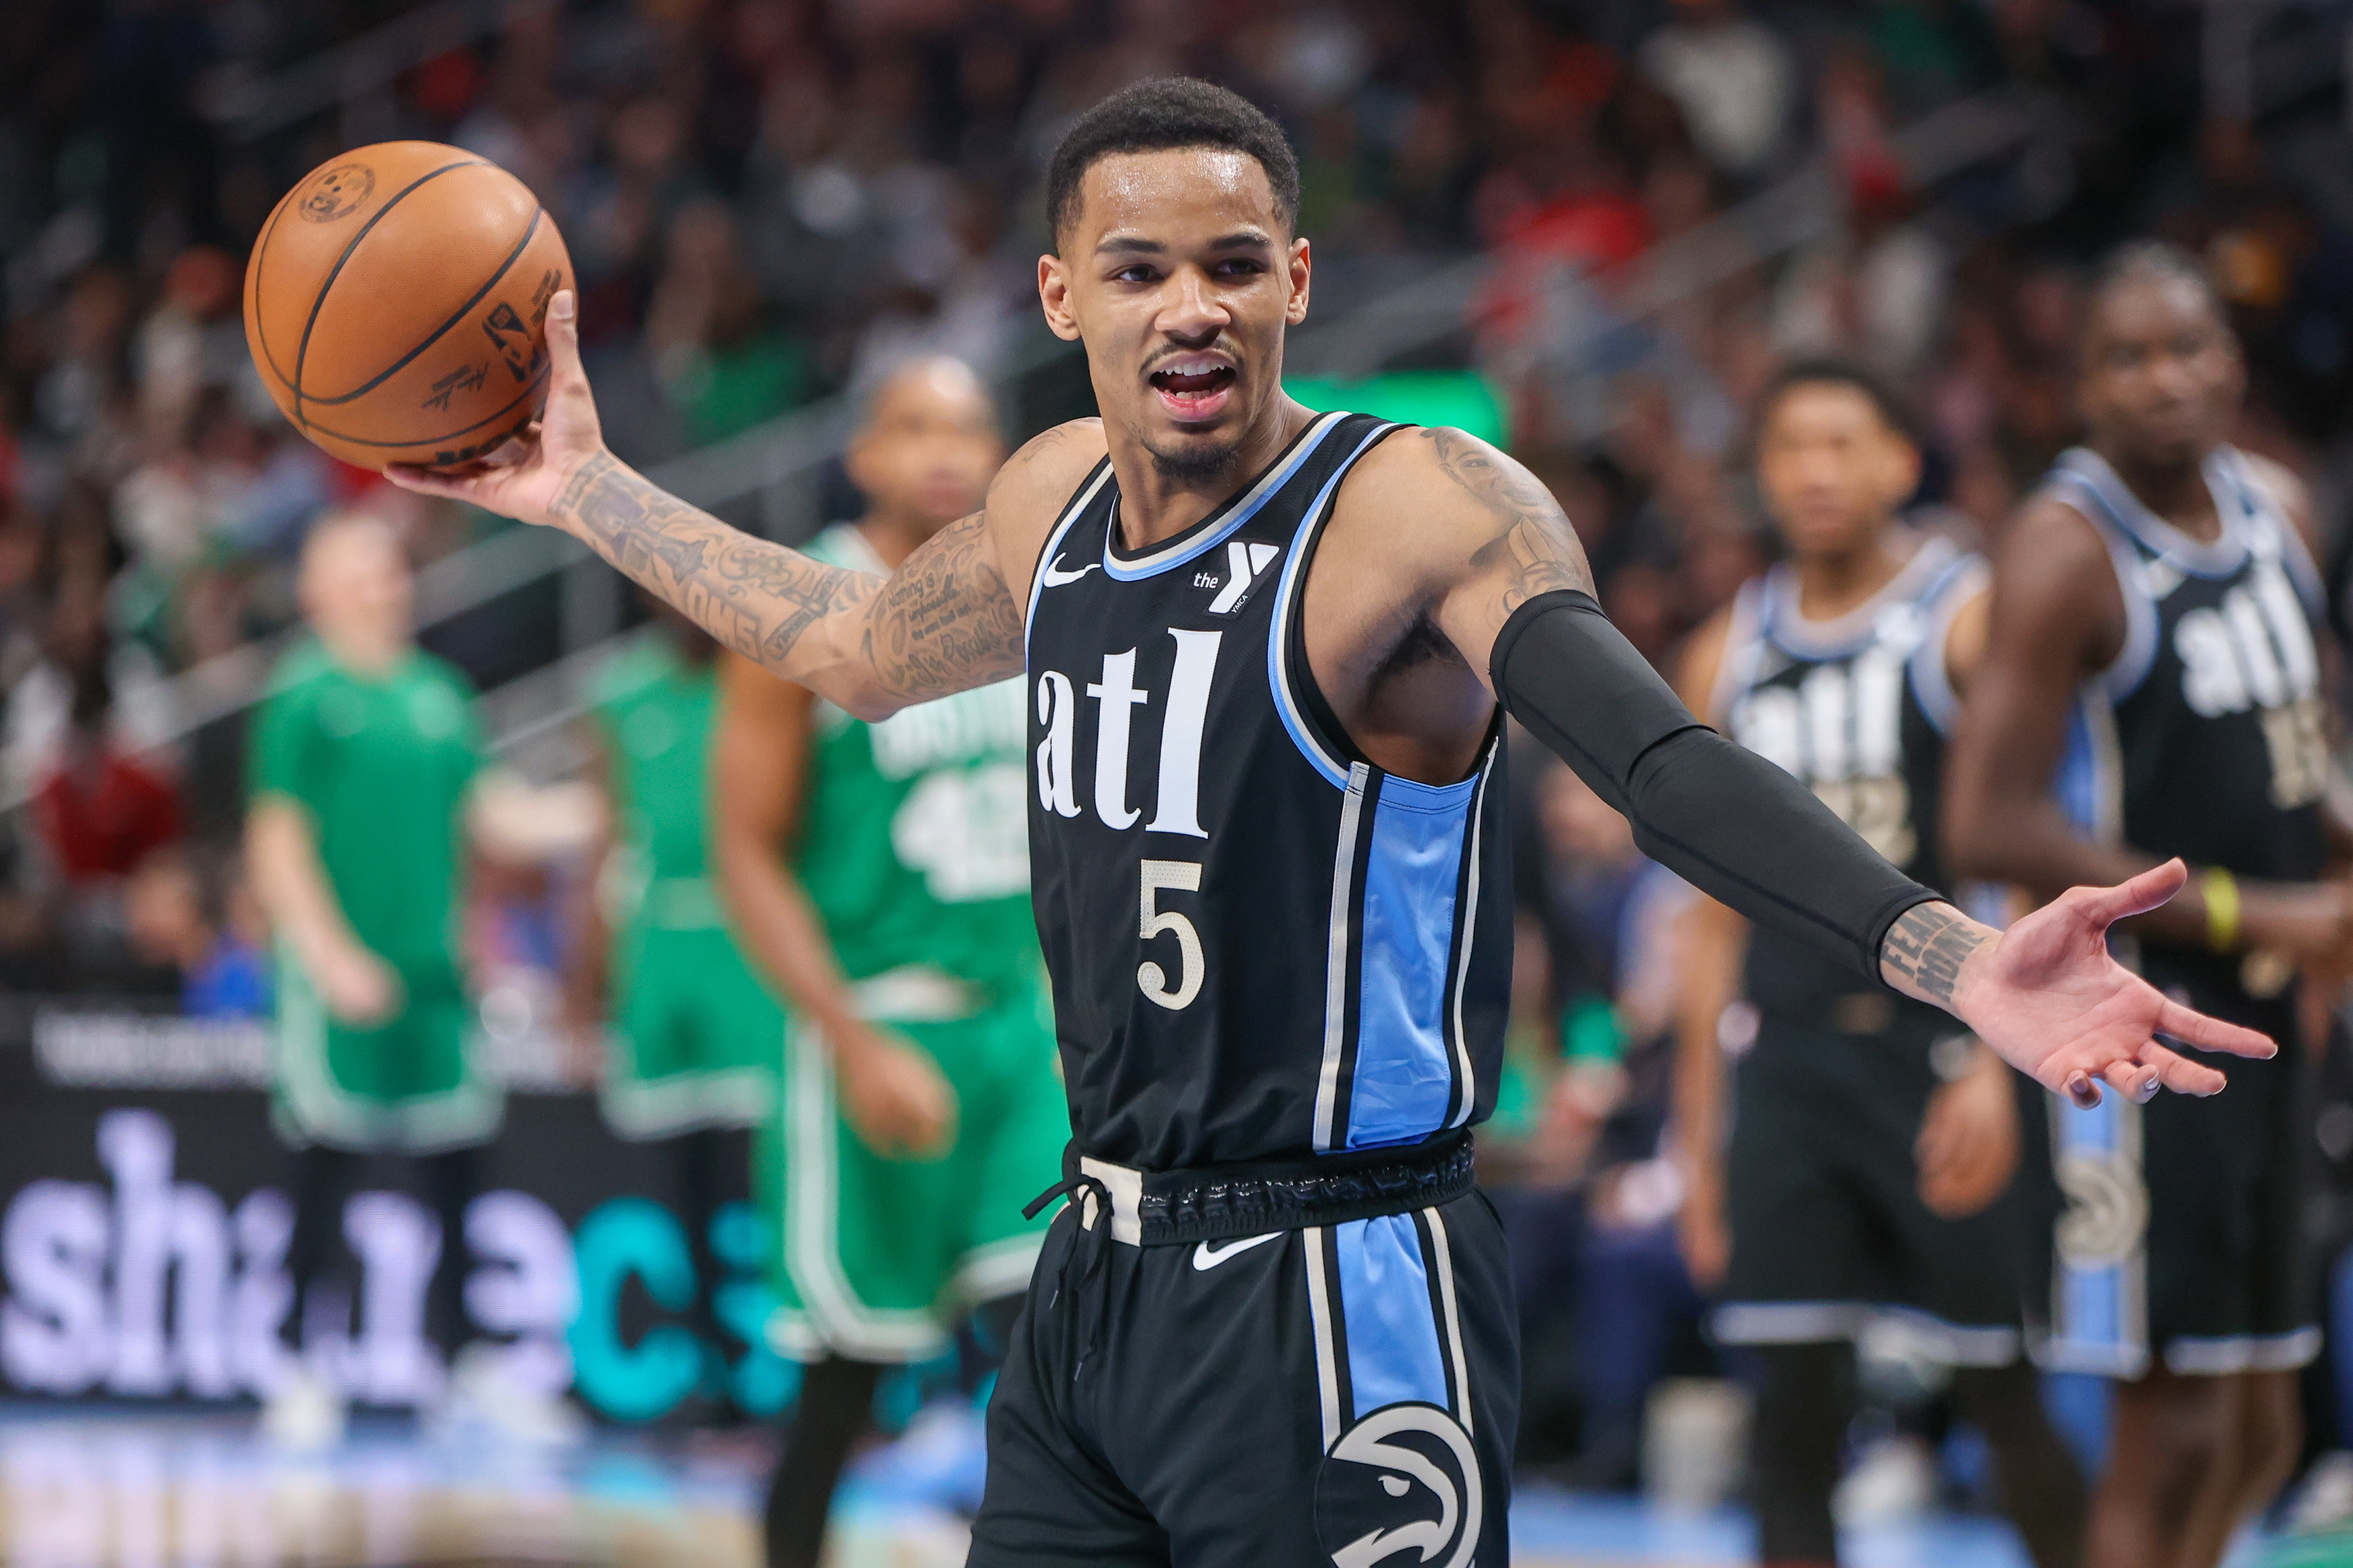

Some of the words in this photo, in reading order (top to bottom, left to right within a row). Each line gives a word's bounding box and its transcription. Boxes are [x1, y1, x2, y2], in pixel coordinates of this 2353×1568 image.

[1193, 573, 1218, 588] the
[1231, 595, 1248, 613] YMCA
[1036, 627, 1222, 839] atl
[1137, 859, 1205, 1011] 5
[1880, 904, 1953, 978] FEAR
[1917, 922, 1988, 1002] NONE
